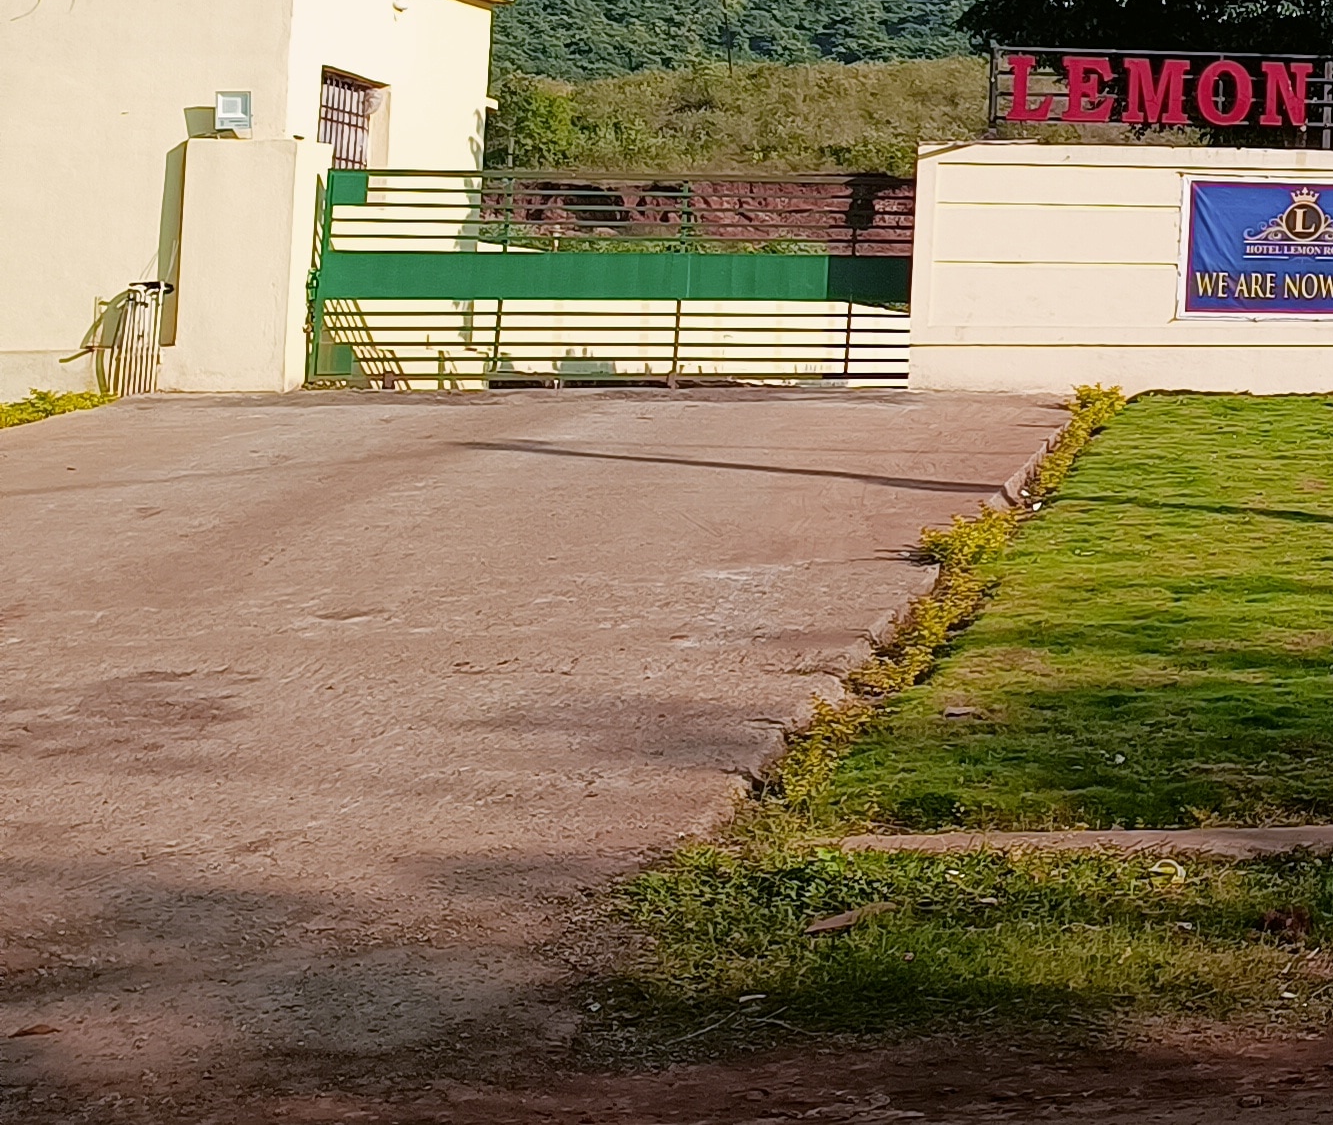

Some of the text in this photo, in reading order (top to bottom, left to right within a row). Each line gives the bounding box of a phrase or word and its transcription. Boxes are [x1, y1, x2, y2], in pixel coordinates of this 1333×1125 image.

[1006, 54, 1314, 127] LEMON
[1292, 208, 1316, 234] L
[1245, 245, 1282, 254] HOTEL
[1283, 245, 1321, 255] LEMON
[1195, 272, 1229, 298] WE
[1234, 273, 1276, 299] ARE
